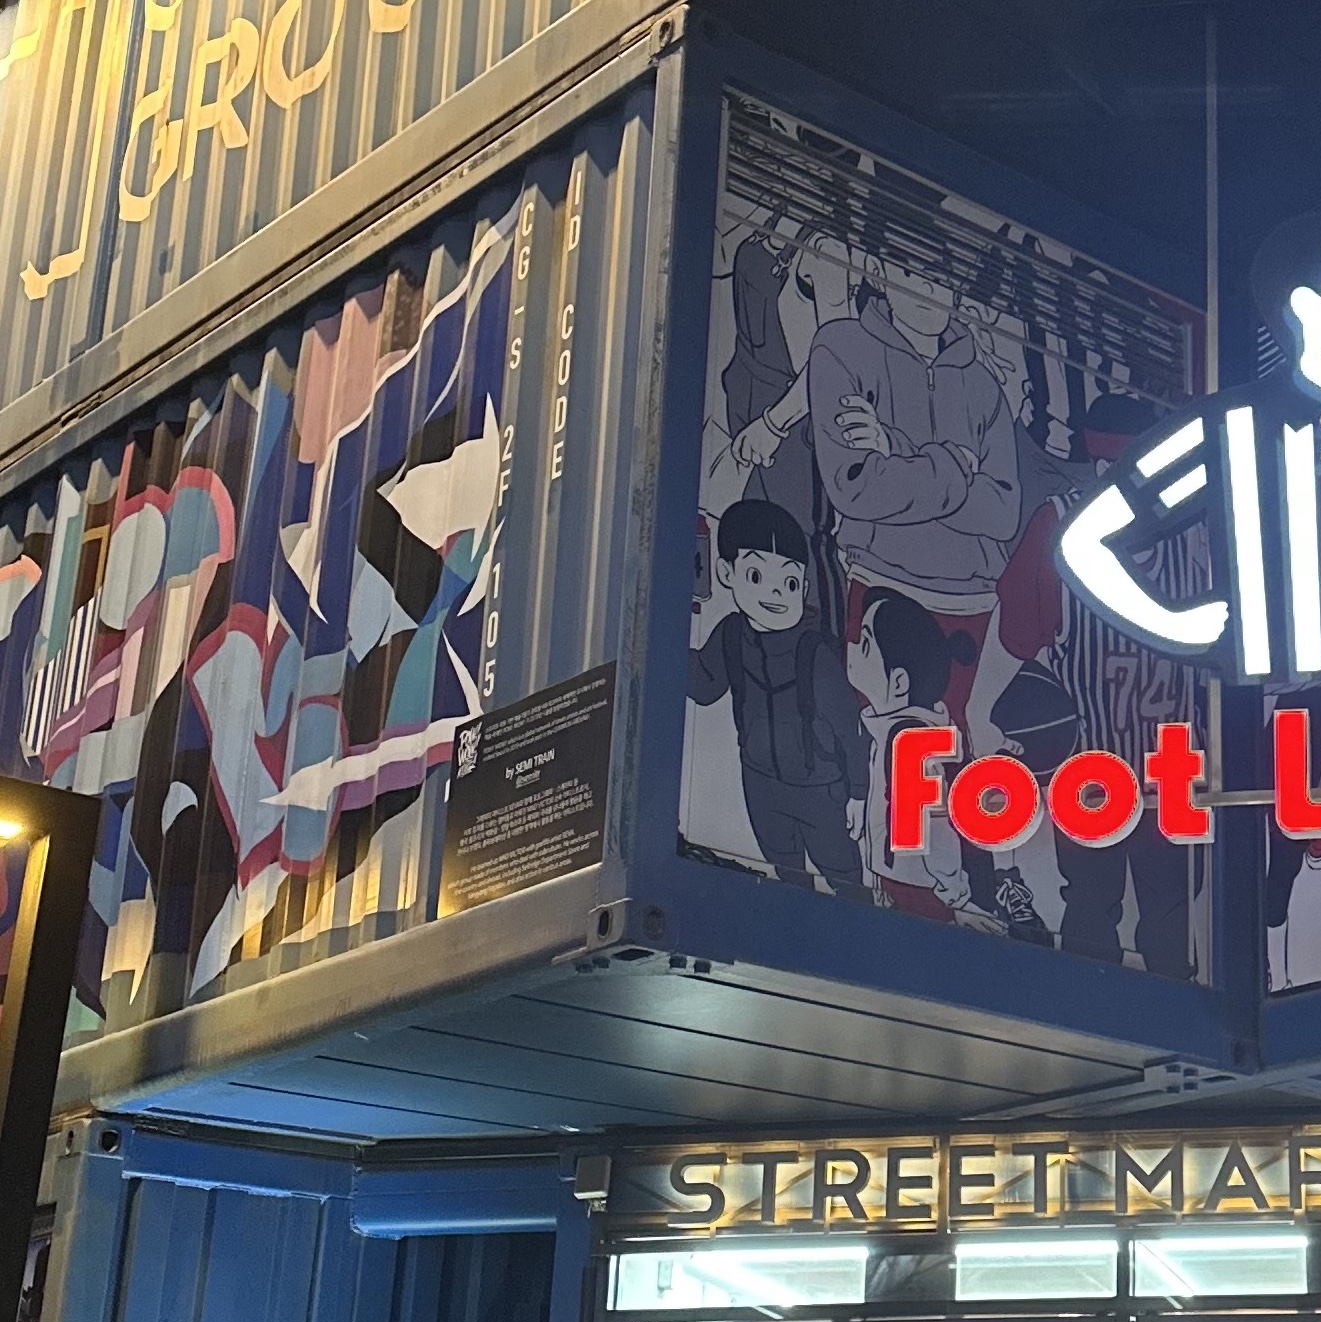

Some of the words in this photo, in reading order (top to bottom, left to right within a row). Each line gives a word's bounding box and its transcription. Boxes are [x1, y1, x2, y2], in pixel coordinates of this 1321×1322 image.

[551, 303, 575, 481] CODE
[889, 722, 1214, 854] Foot
[667, 1141, 1069, 1229] STREET
